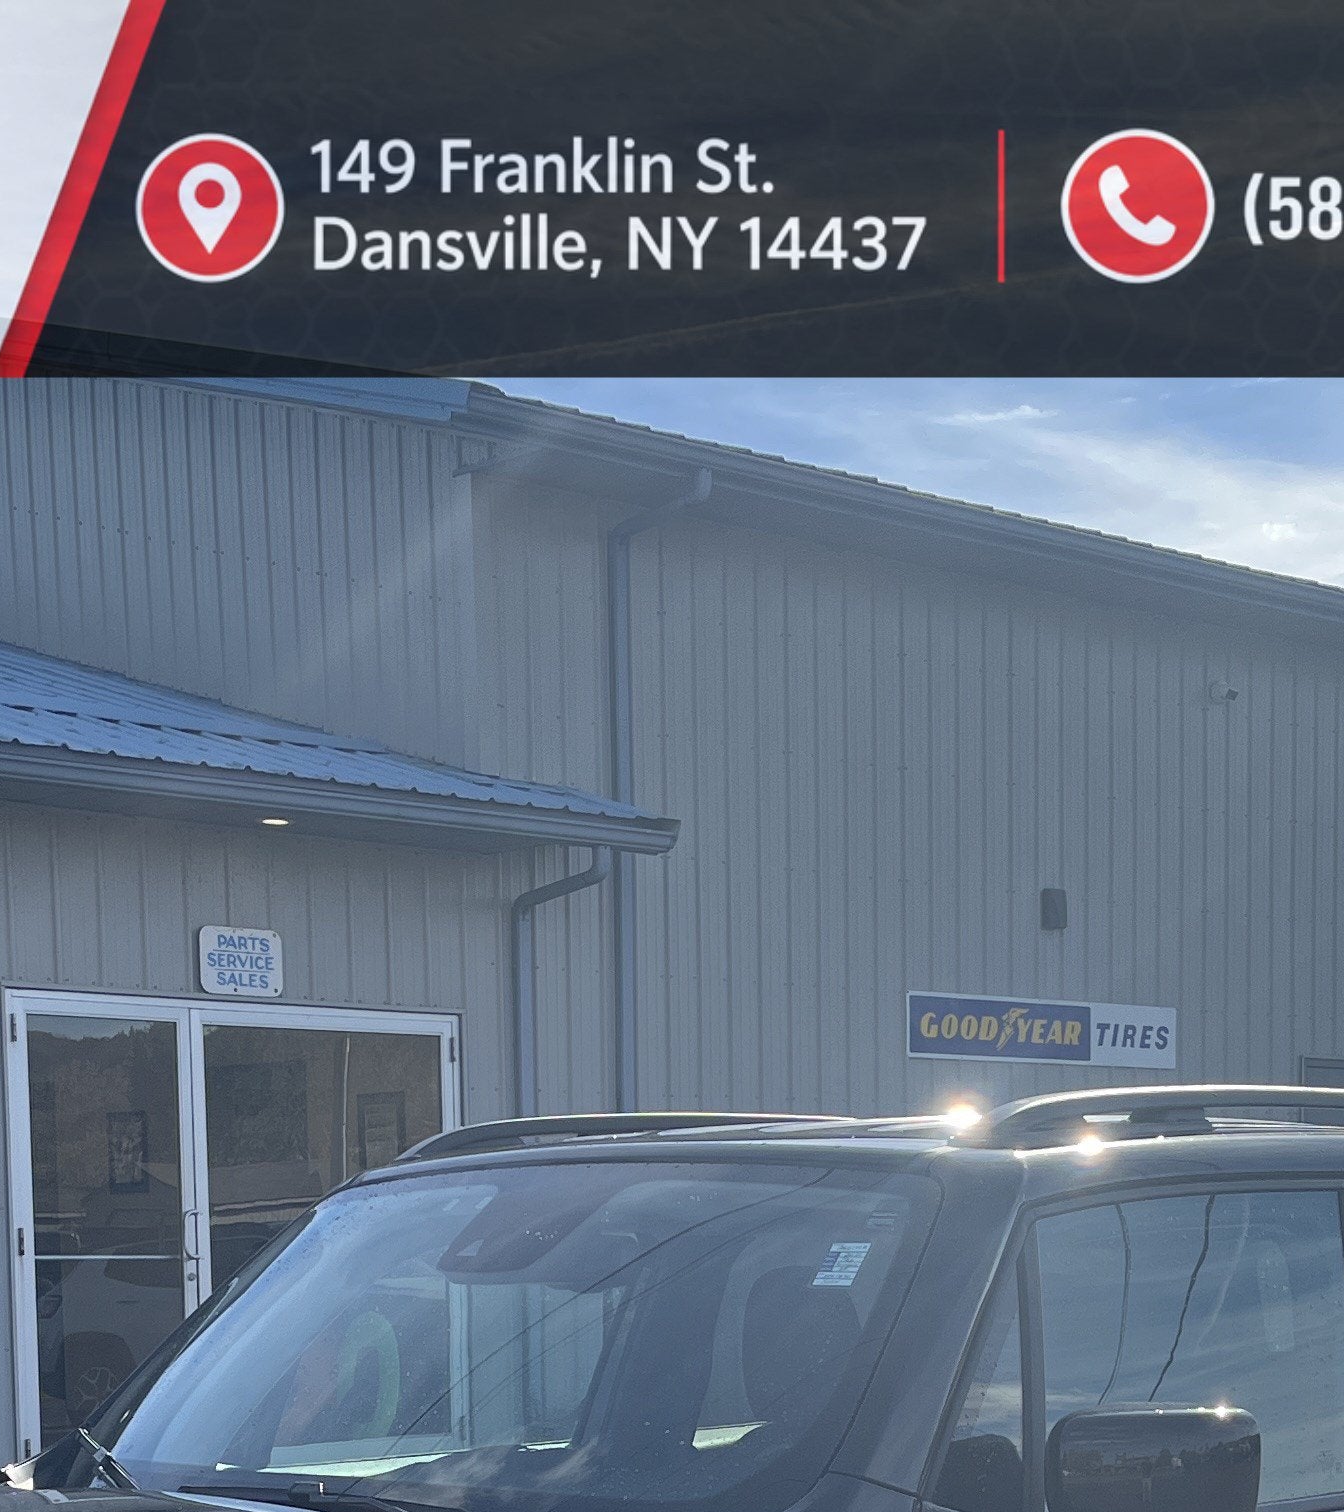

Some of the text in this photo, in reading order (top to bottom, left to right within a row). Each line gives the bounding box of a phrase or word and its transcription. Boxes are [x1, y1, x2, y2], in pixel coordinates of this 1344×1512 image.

[217, 934, 270, 952] PARTS
[207, 952, 275, 970] SERVICE
[217, 972, 269, 989] SALES
[1096, 1022, 1170, 1050] TIRES
